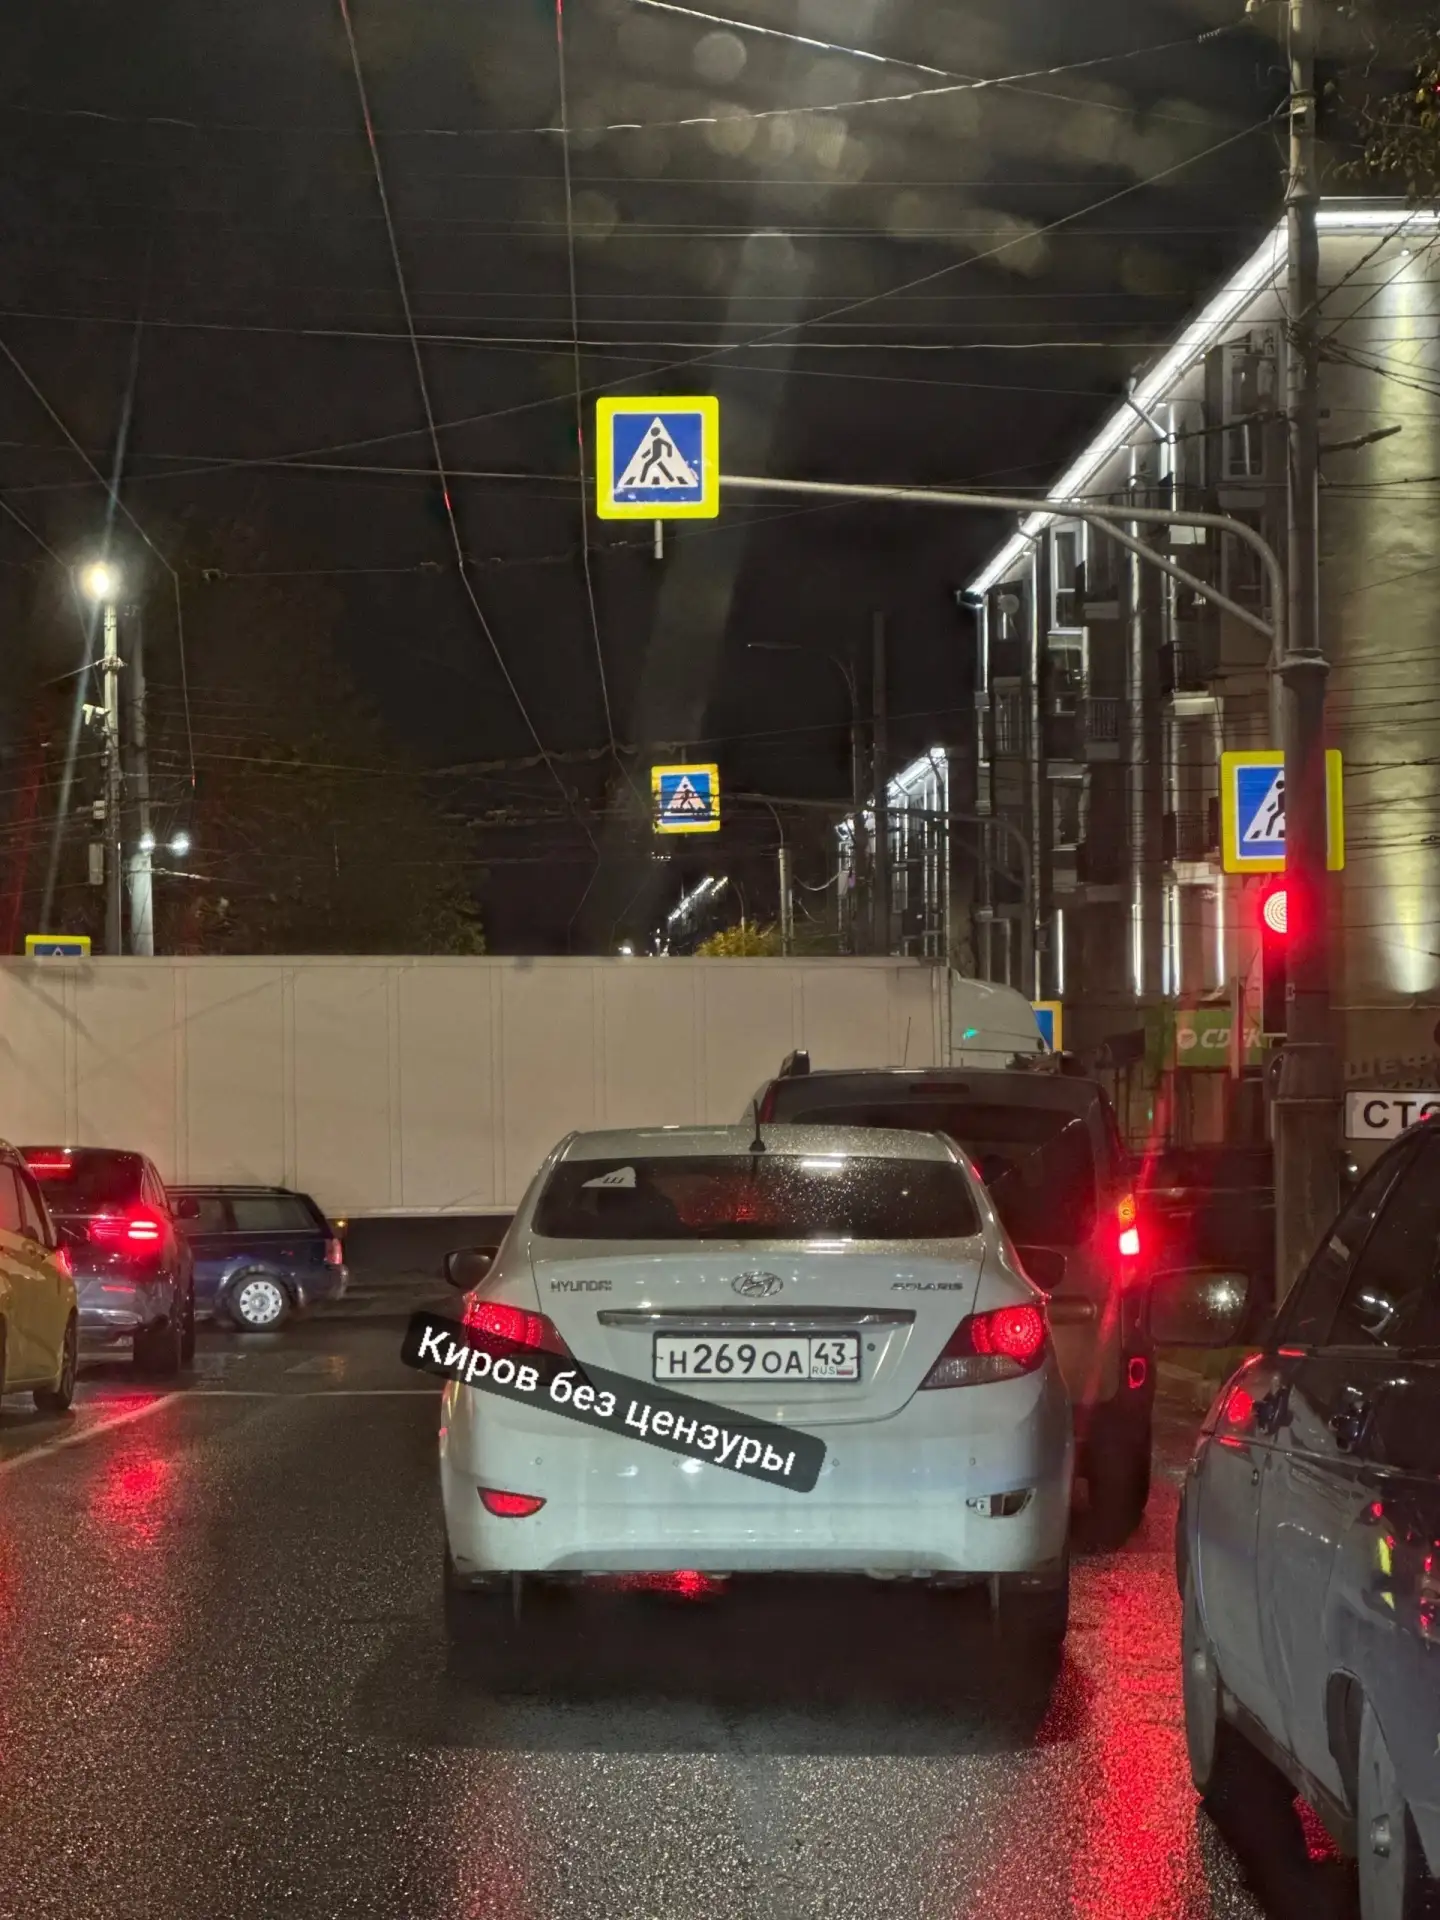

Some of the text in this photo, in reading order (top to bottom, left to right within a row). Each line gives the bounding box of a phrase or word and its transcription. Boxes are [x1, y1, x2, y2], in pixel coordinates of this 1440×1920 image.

[550, 1280, 612, 1292] HYUNDAI
[890, 1282, 963, 1292] SOLARIS
[814, 1342, 847, 1366] 43
[812, 1366, 836, 1375] RUS
